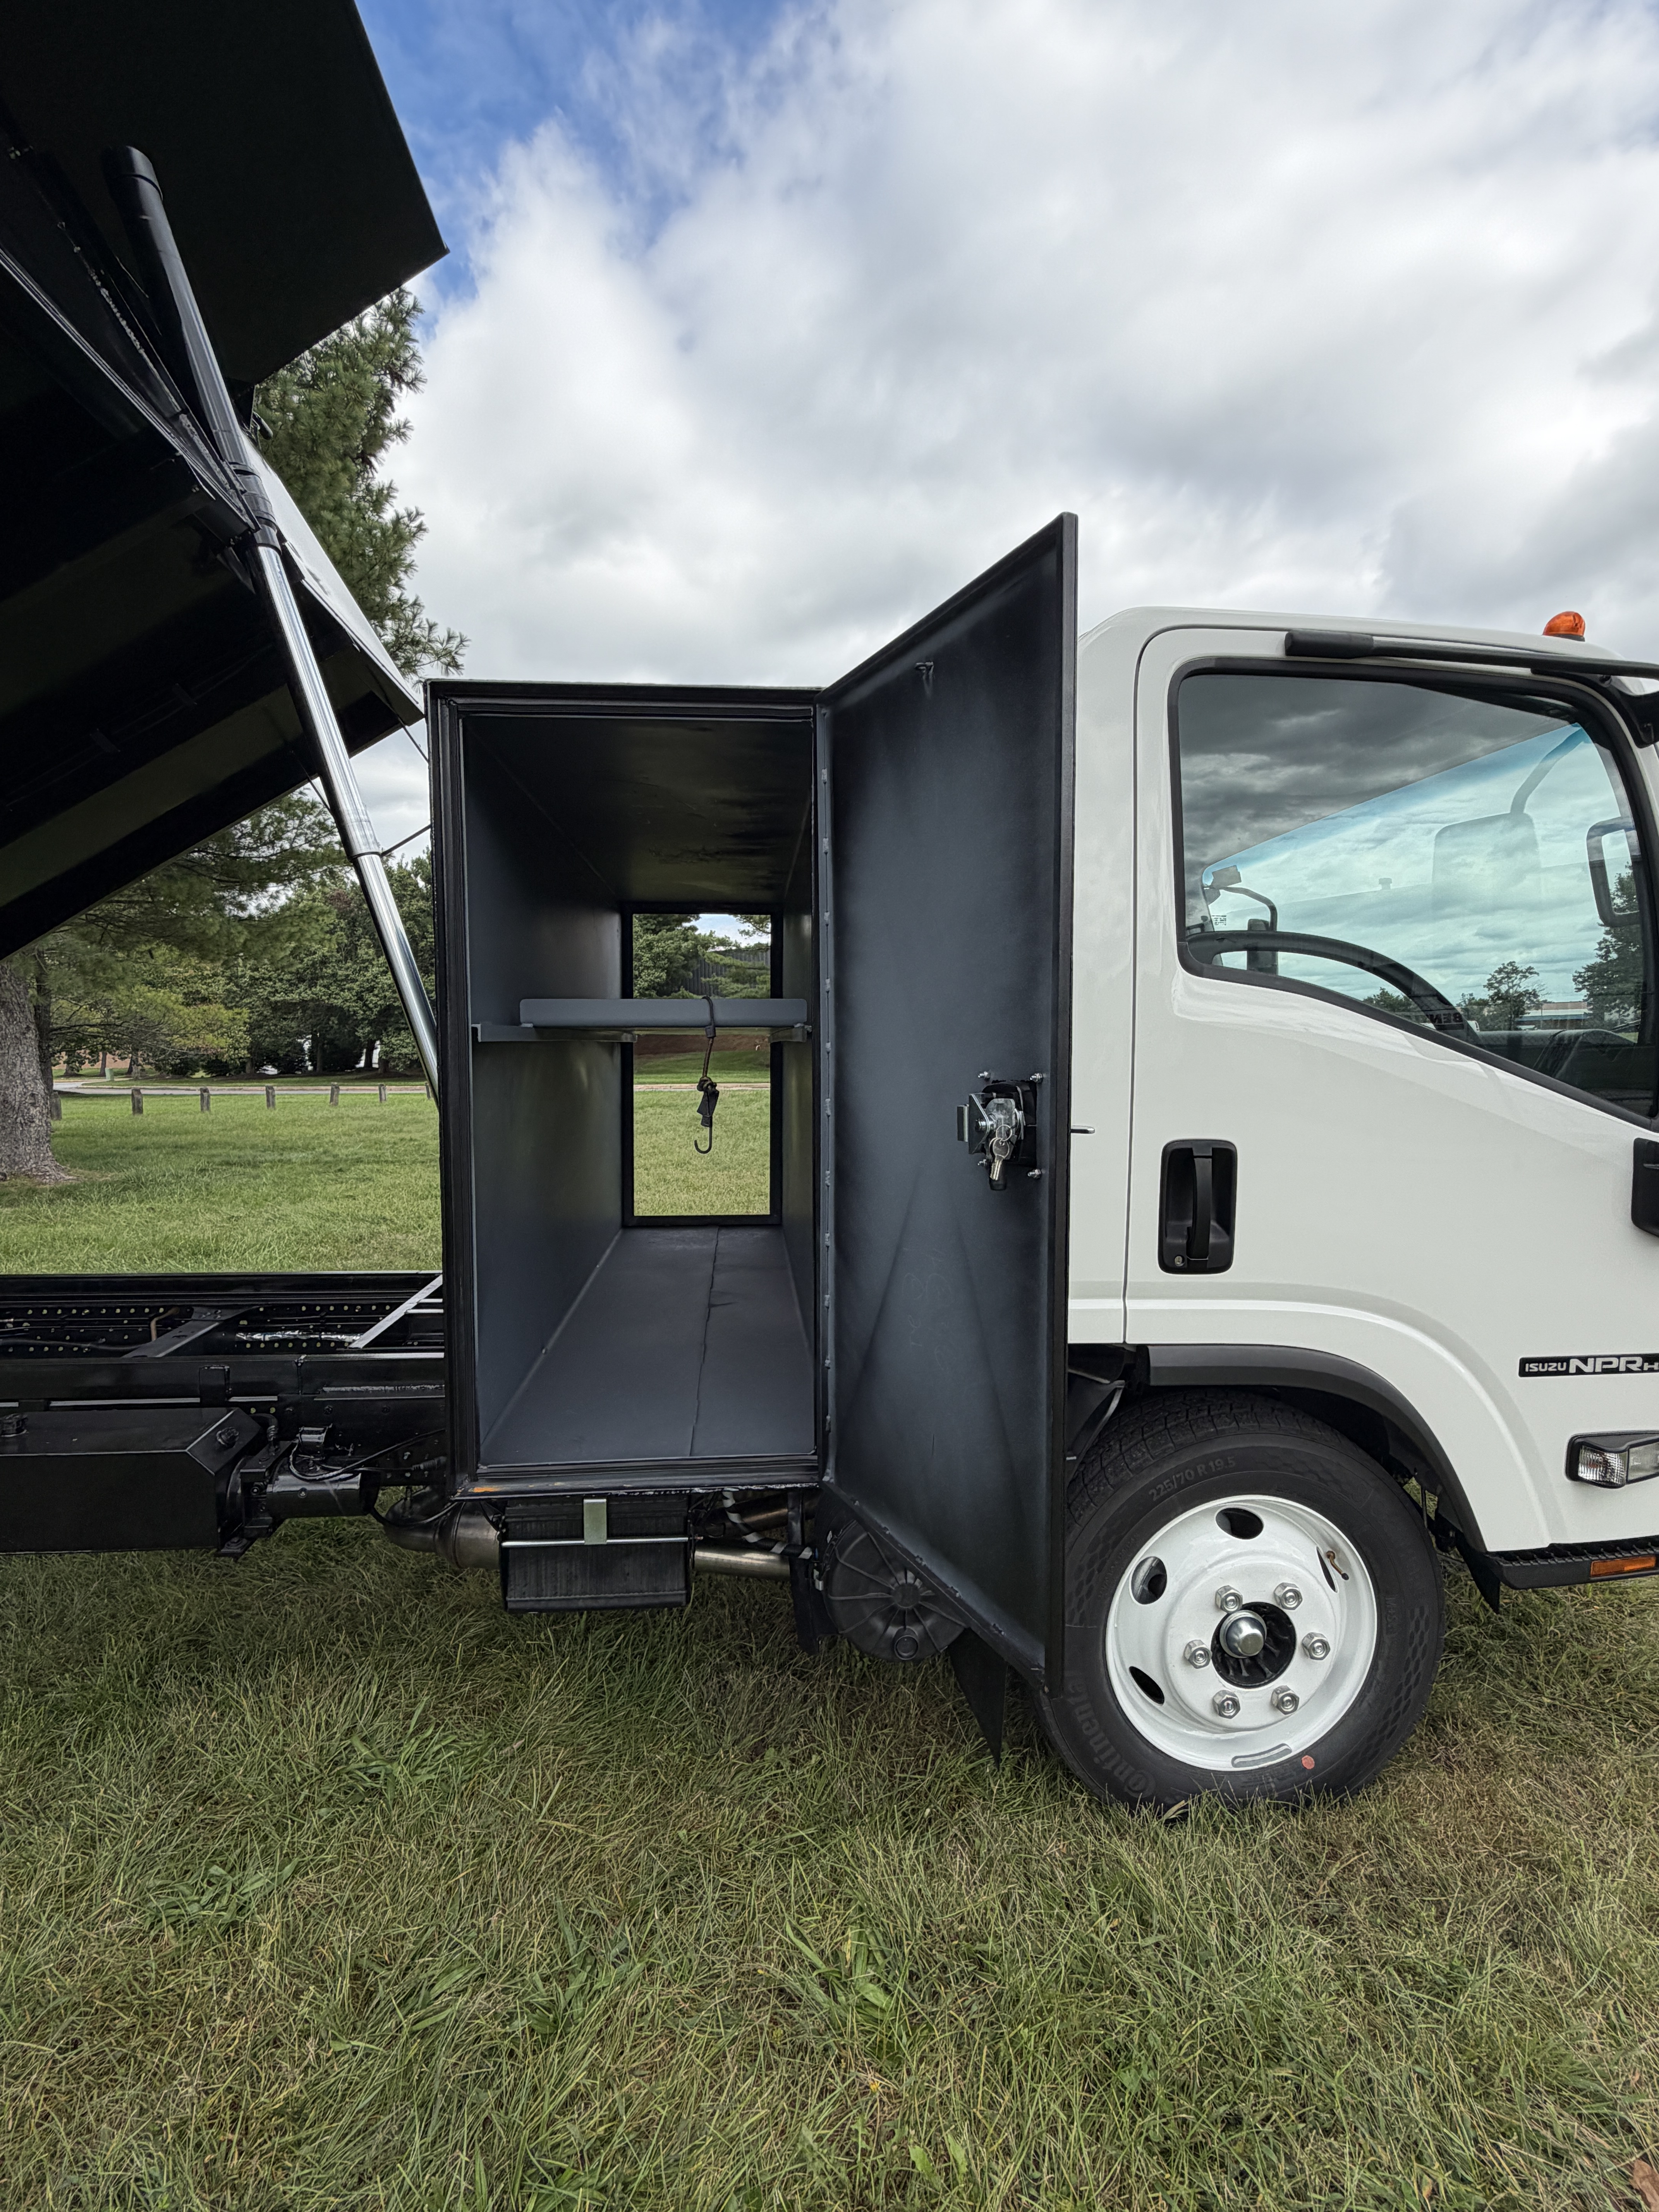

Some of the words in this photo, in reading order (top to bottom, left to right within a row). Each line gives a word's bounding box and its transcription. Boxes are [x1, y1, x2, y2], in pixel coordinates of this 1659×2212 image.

[1525, 1362, 1567, 1372] ISUZU
[1569, 1357, 1643, 1373] NPR
[1149, 1469, 1195, 1501] 225/70
[1196, 1464, 1208, 1476] R
[1208, 1456, 1236, 1472] 19.5
[1064, 1670, 1156, 1798] Continental
